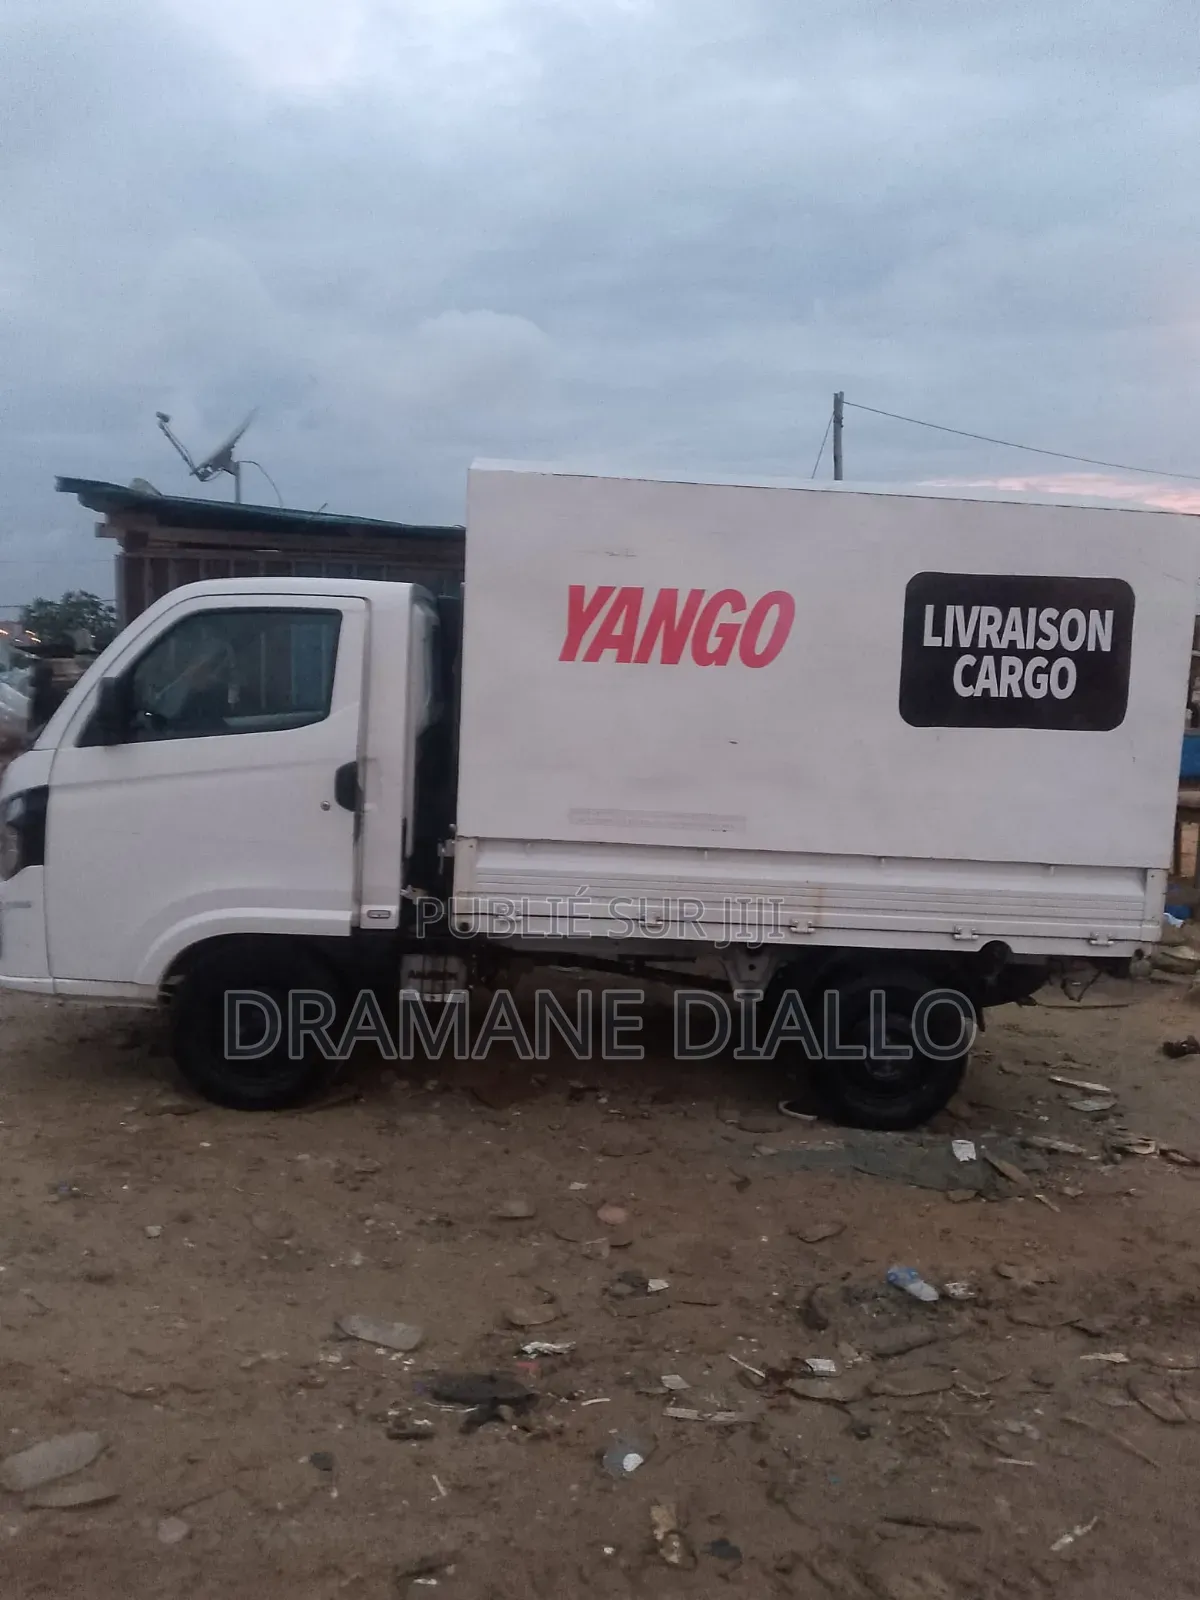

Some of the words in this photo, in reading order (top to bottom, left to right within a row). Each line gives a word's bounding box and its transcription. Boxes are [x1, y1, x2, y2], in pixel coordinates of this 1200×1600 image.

[558, 585, 795, 668] YANGO
[923, 604, 1114, 652] LIVRAISON
[953, 654, 1077, 700] CARGO
